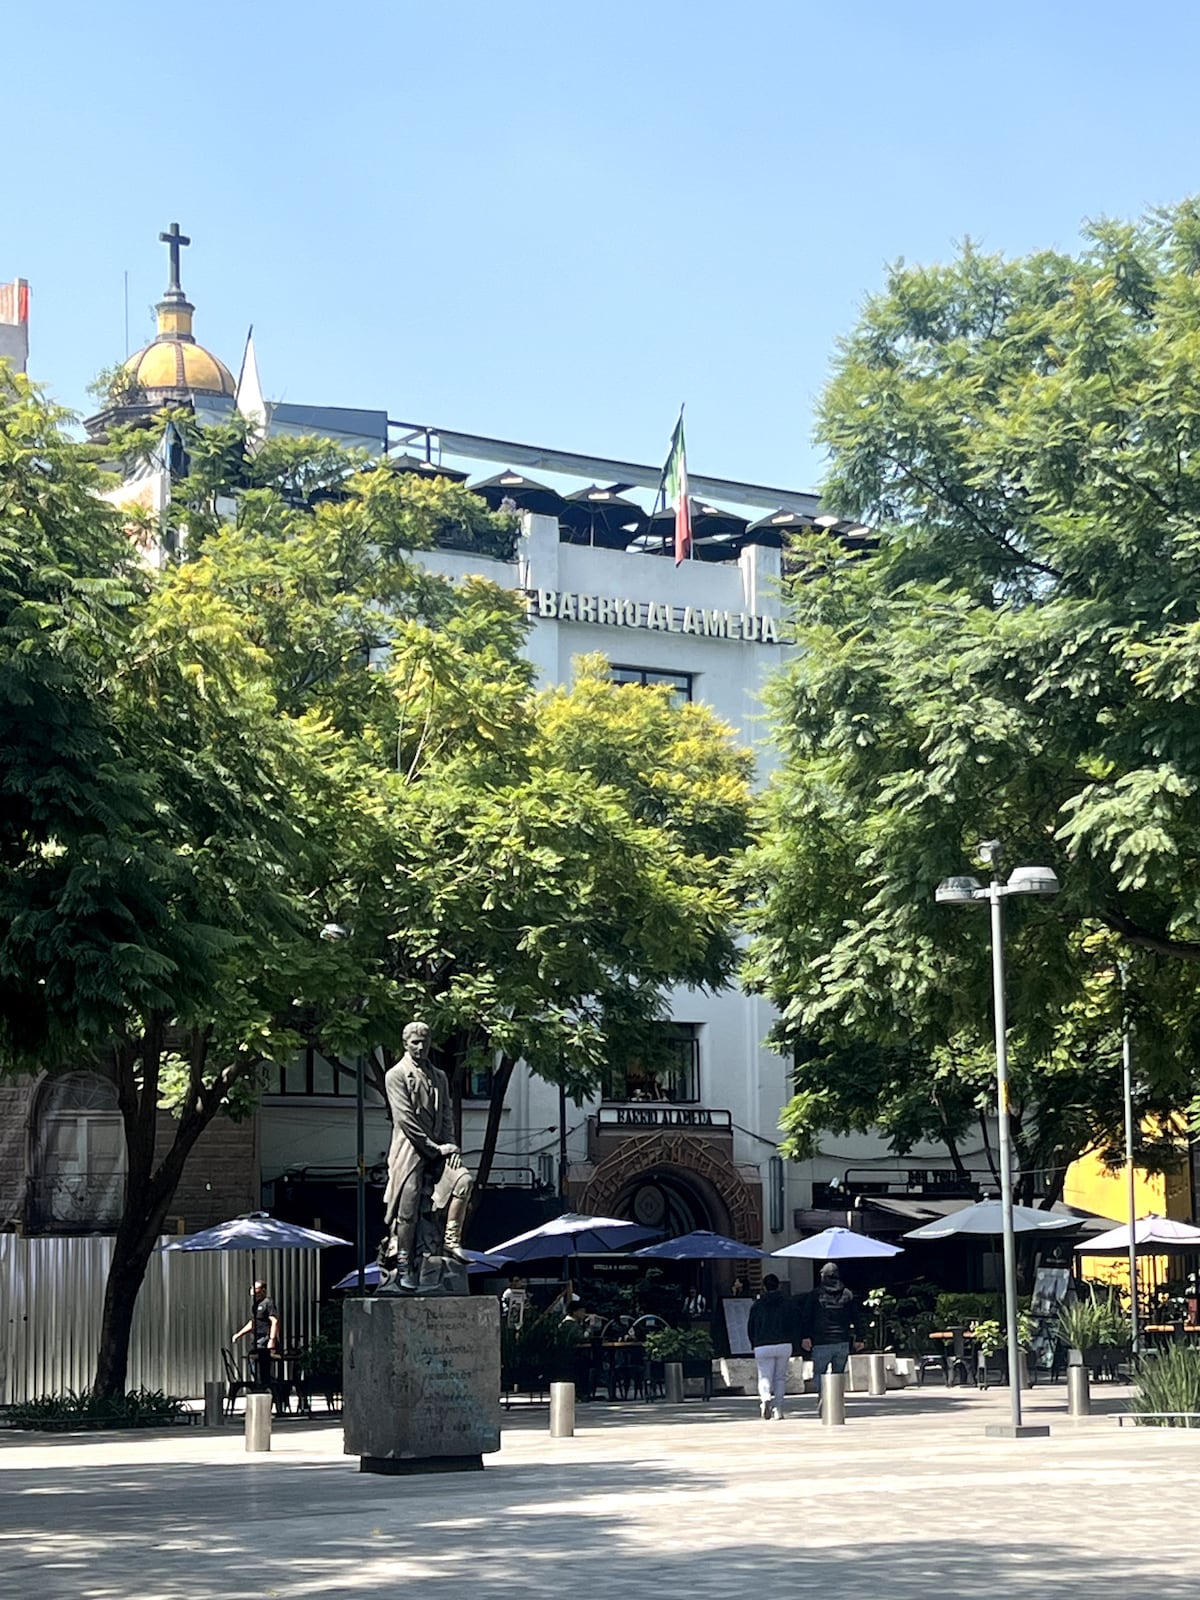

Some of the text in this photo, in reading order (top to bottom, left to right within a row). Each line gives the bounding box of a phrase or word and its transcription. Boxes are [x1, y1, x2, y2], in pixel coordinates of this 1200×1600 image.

[537, 588, 641, 628] BARRIO
[647, 601, 779, 644] ALAMEDA
[617, 1109, 713, 1125] BARRIO ALAMEDA
